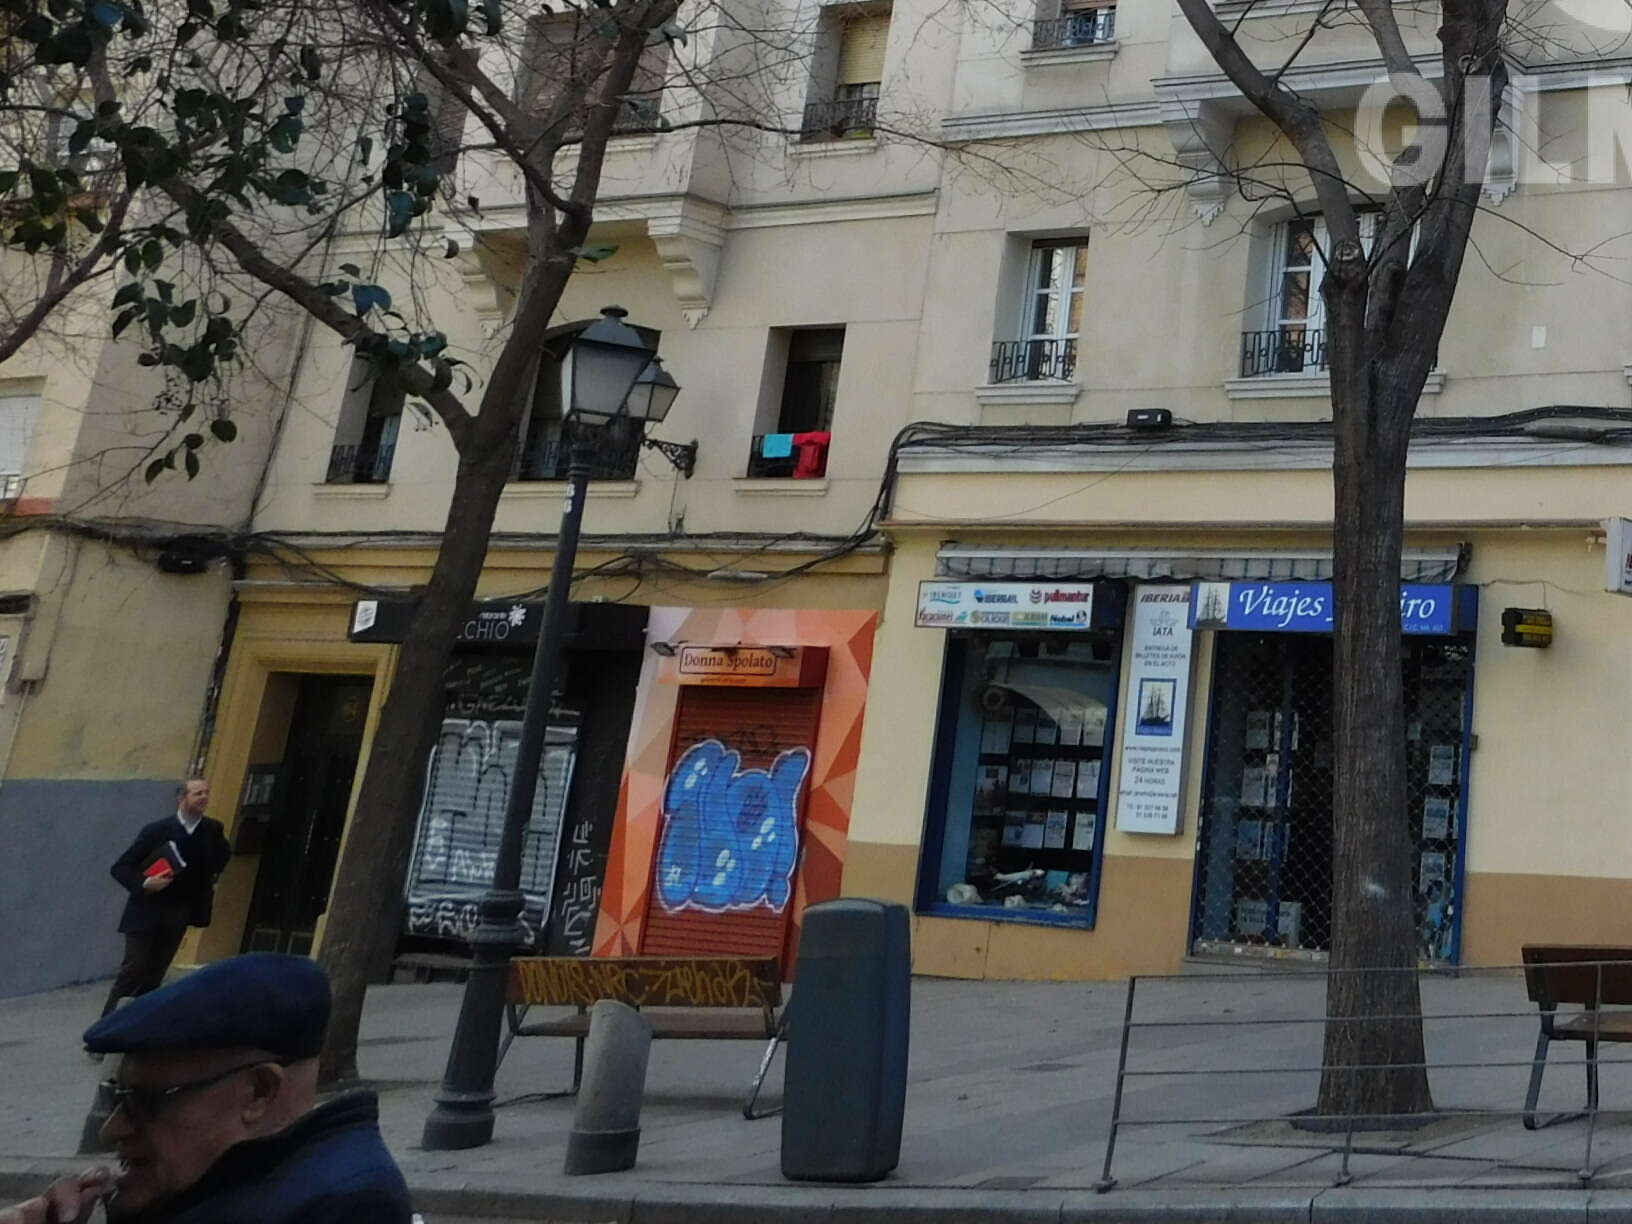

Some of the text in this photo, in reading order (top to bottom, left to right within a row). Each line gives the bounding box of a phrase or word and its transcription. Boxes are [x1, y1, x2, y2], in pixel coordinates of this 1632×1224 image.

[1141, 594, 1181, 604] IBERIA
[1238, 585, 1324, 628] Viajes
[1153, 628, 1173, 636] IATA
[683, 653, 723, 667] Donna
